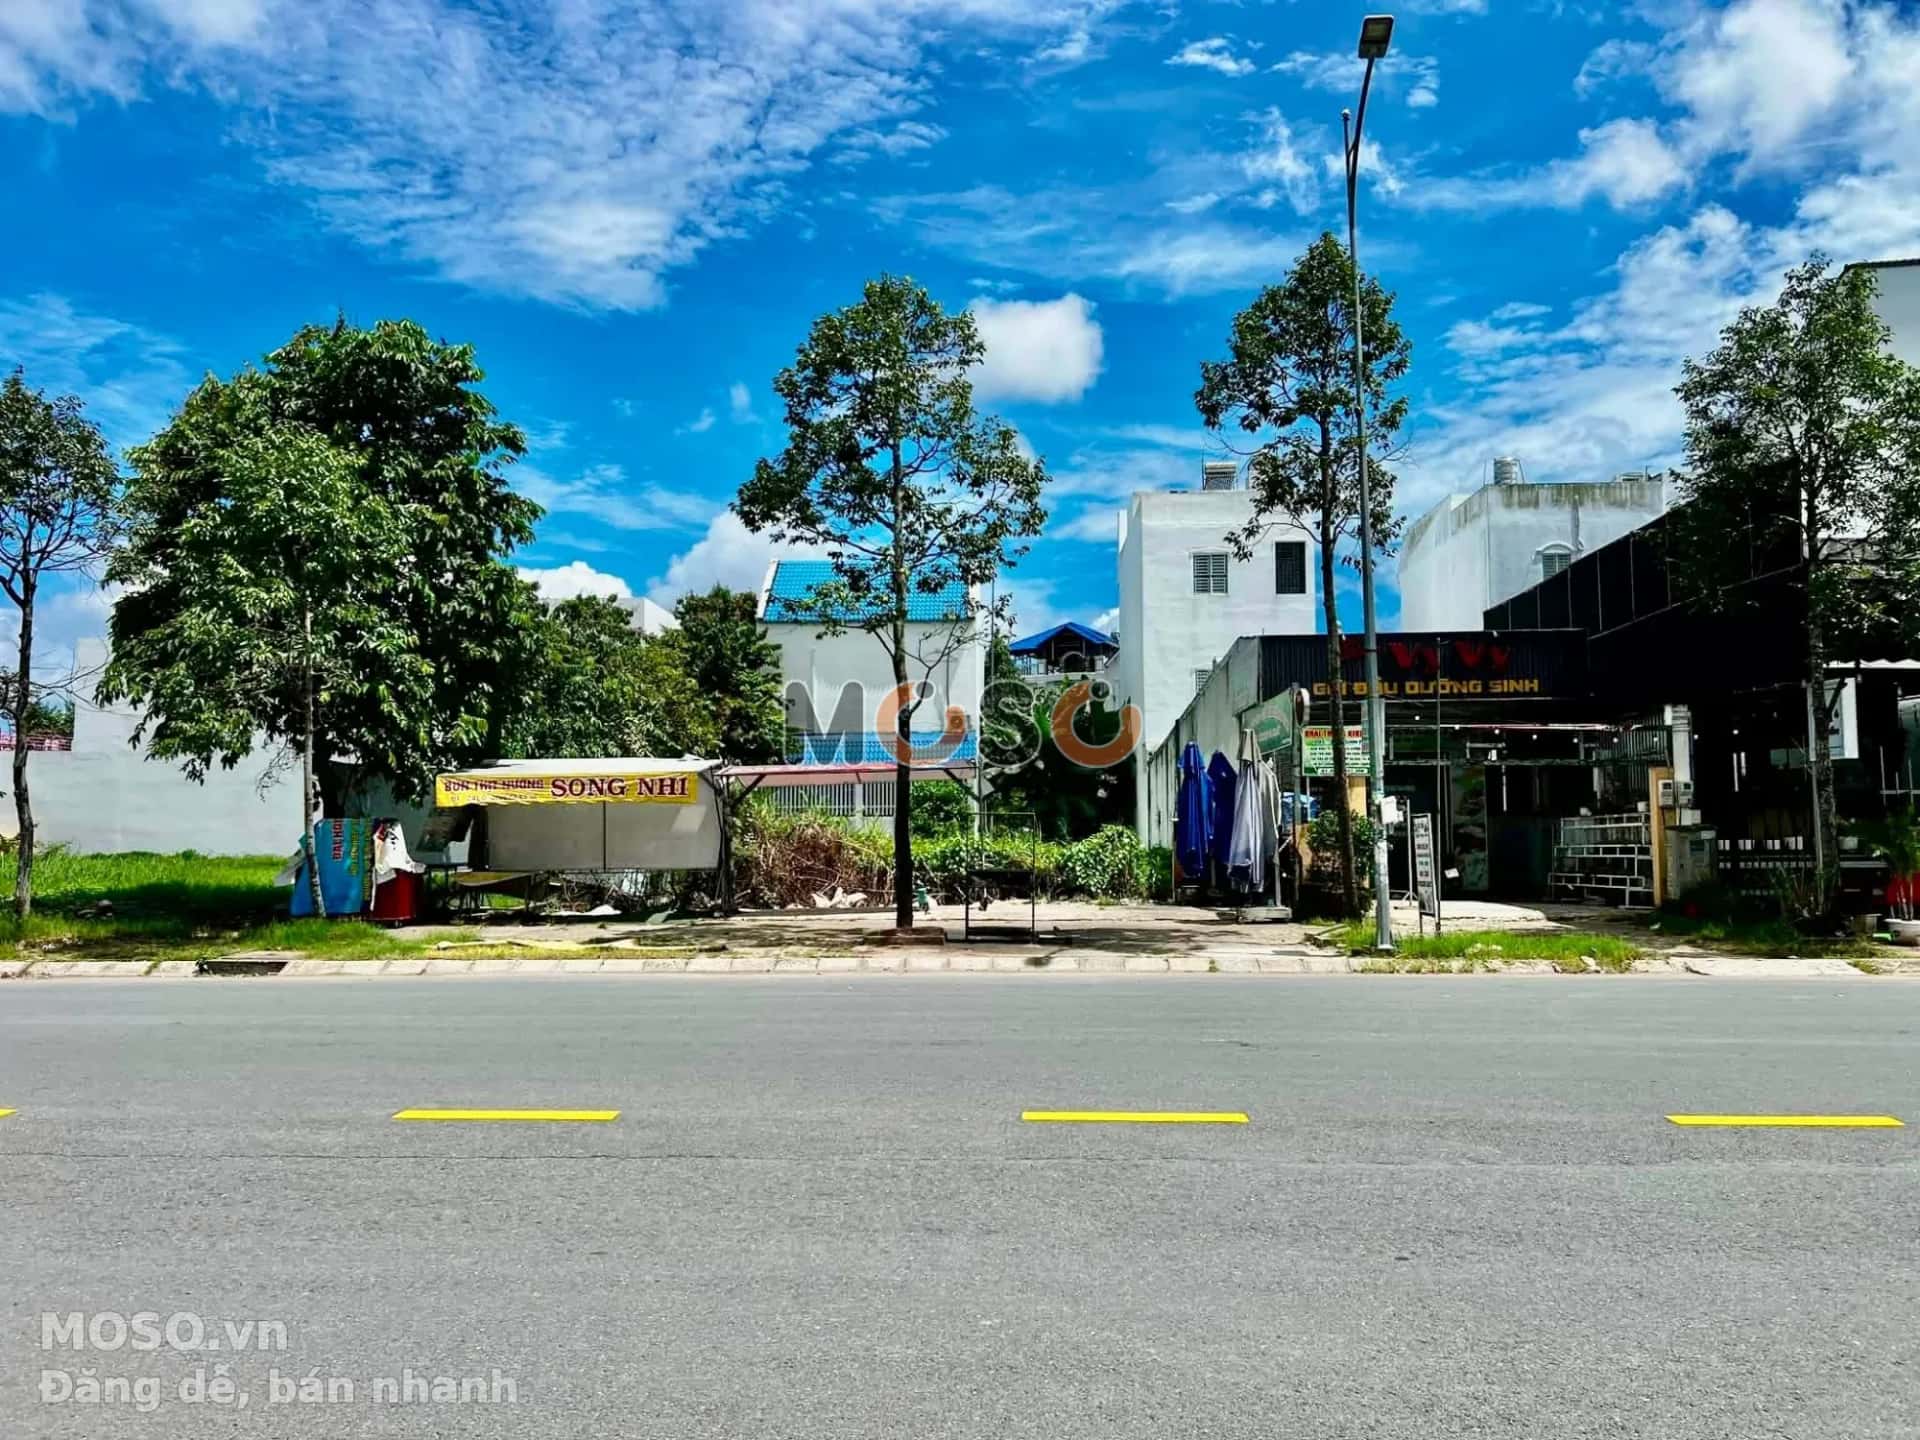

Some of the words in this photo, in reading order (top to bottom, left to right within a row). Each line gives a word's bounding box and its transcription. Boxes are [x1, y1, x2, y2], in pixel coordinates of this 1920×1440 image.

[1489, 679, 1539, 693] SINH
[551, 777, 627, 797] SONG
[637, 777, 688, 796] NHI
